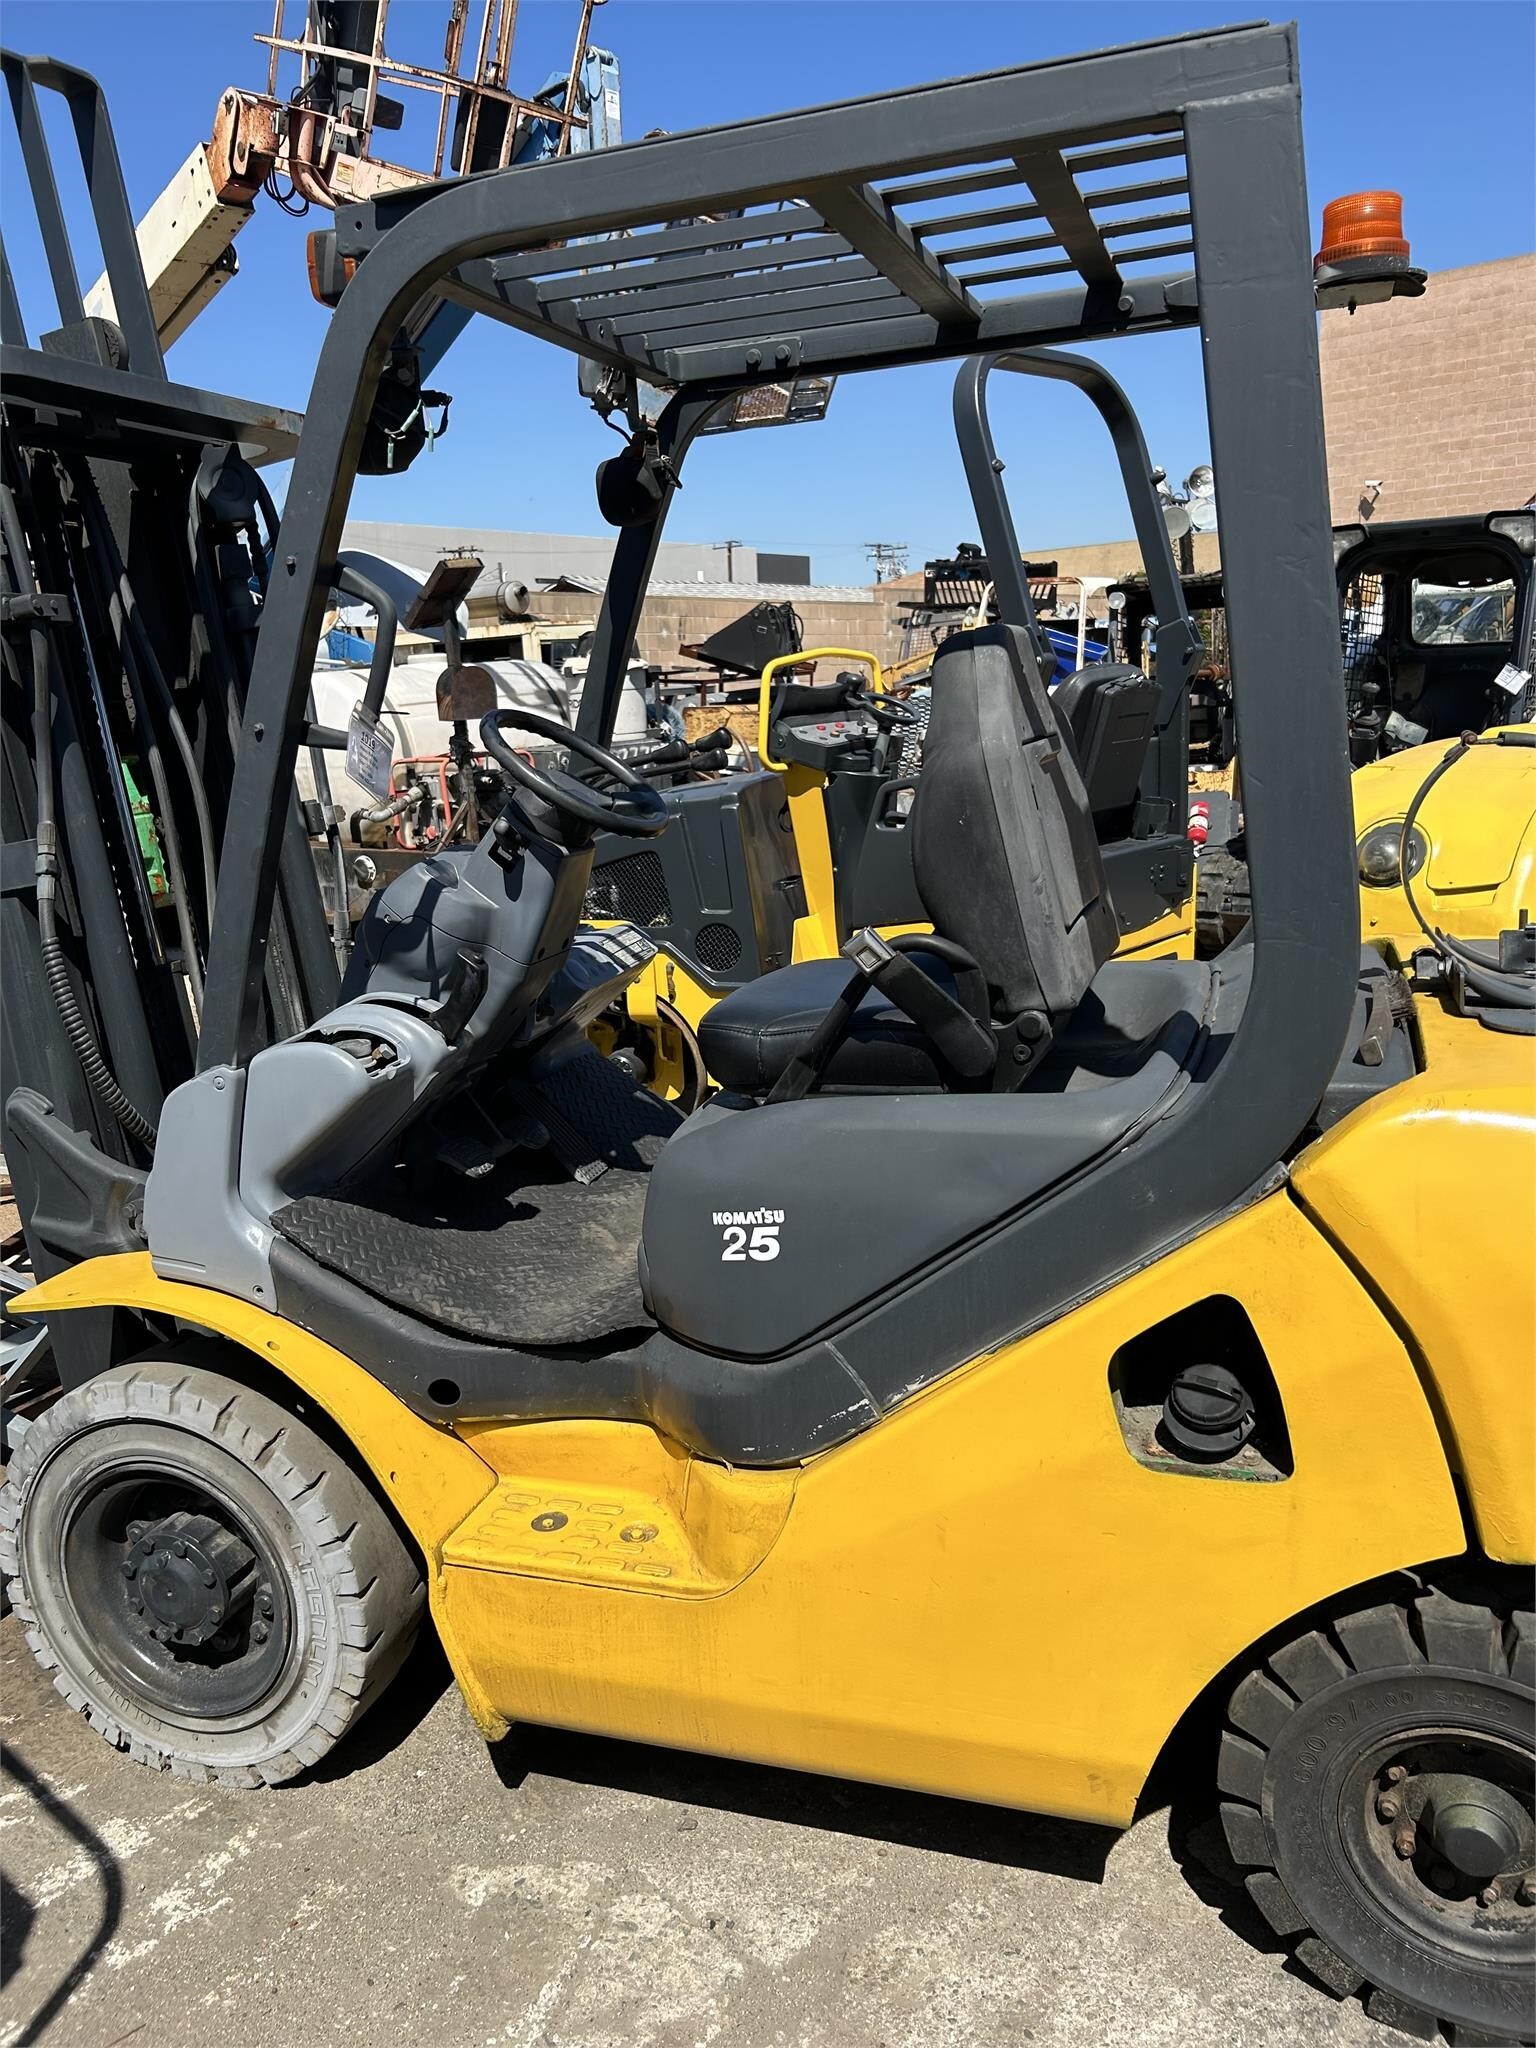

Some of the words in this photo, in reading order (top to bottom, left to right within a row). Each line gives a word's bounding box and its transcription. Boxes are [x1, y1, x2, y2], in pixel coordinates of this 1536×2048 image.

[712, 1207, 785, 1225] KOMATSU
[721, 1226, 780, 1261] 25
[291, 1542, 327, 1687] MAGNUM
